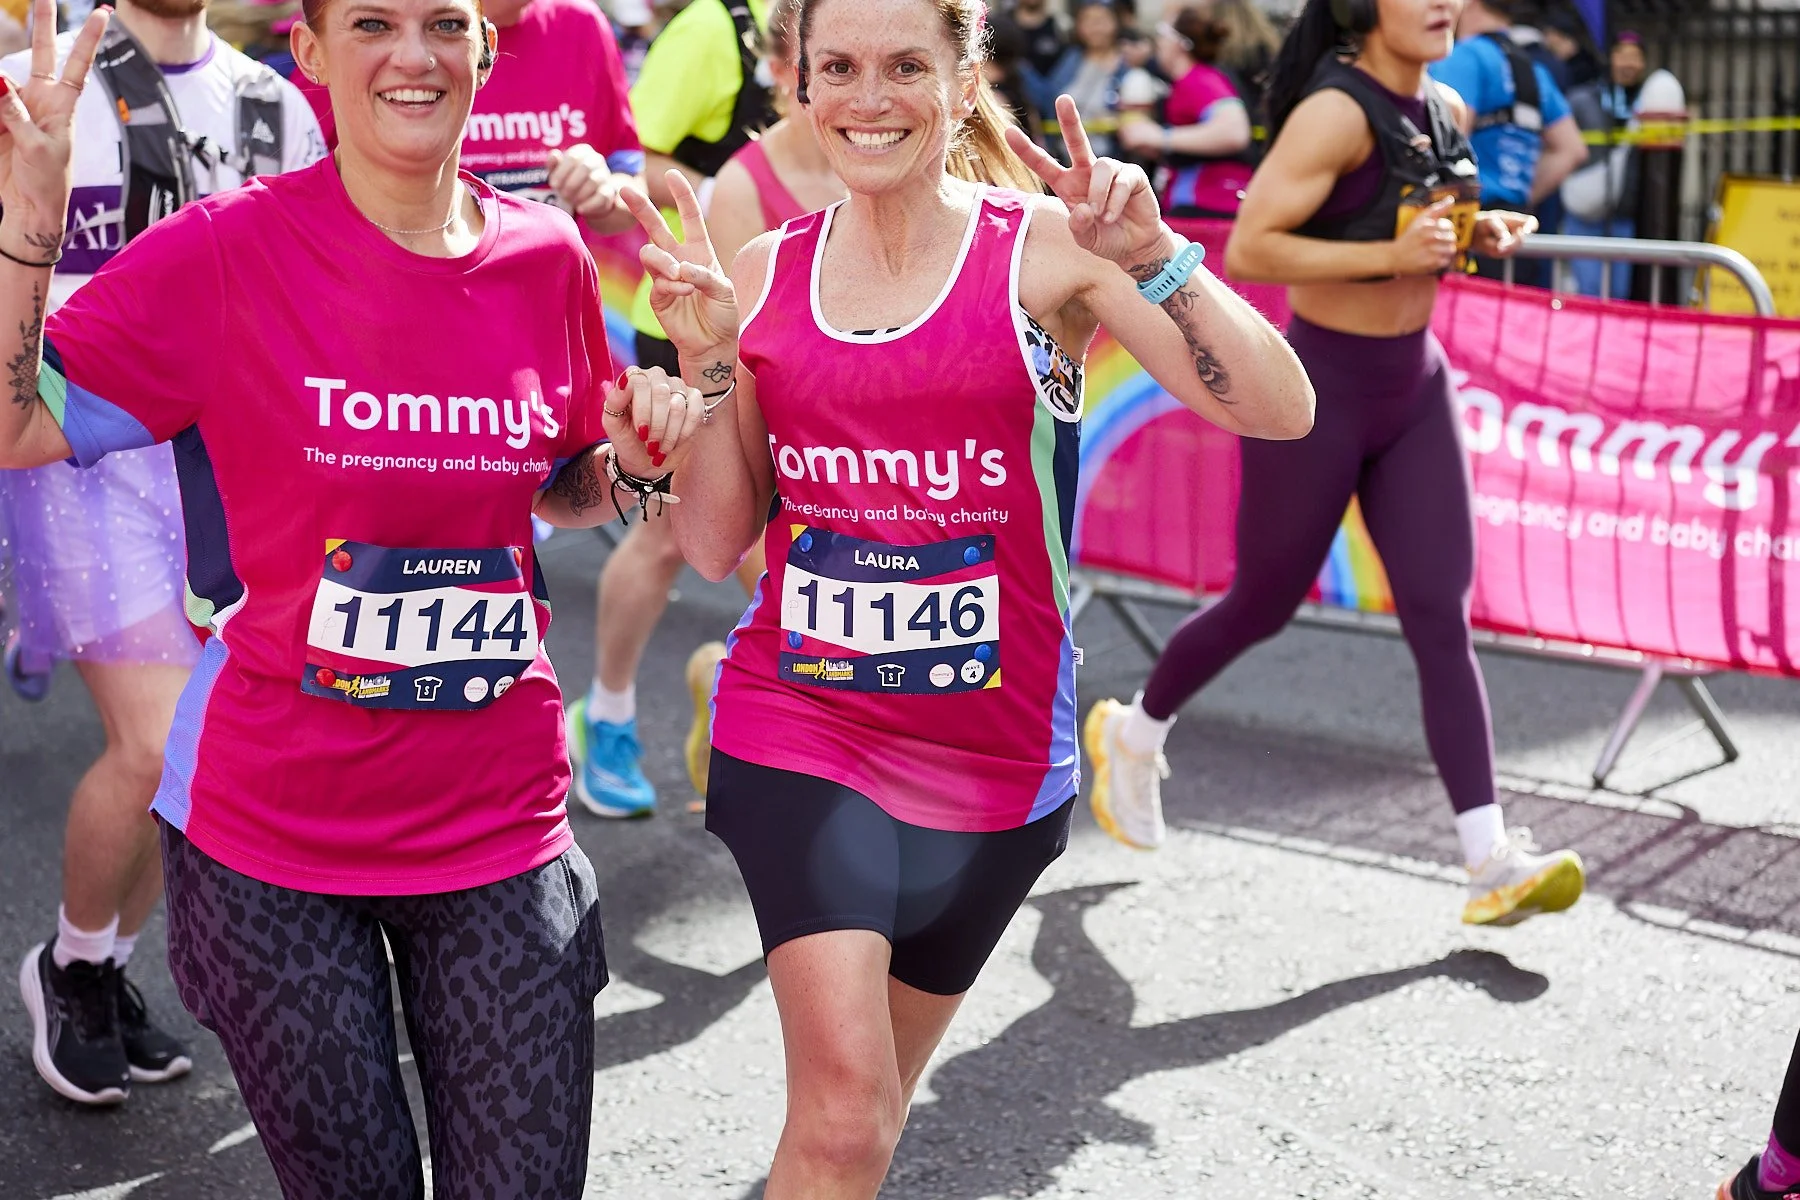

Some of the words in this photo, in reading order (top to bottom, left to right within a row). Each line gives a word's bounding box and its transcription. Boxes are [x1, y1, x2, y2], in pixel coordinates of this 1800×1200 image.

[461, 103, 587, 147] mmy's
[304, 376, 559, 449] Tommy's
[1449, 368, 1800, 511] ommy
[303, 447, 336, 464] The
[342, 453, 437, 471] pregnancy
[443, 455, 475, 471] and
[481, 456, 519, 475] baby
[864, 505, 898, 521] and
[951, 507, 1009, 524] charity
[1473, 492, 1584, 540] egnancy
[1587, 511, 1645, 542] and
[1651, 514, 1728, 560] baby
[402, 559, 481, 575] LAUREN
[854, 549, 920, 571] LAURA
[798, 579, 985, 642] 11146
[334, 596, 528, 652] 11144
[792, 663, 818, 674] LONDON
[888, 672, 894, 682] S
[969, 670, 977, 679] 4
[424, 686, 430, 696] S
